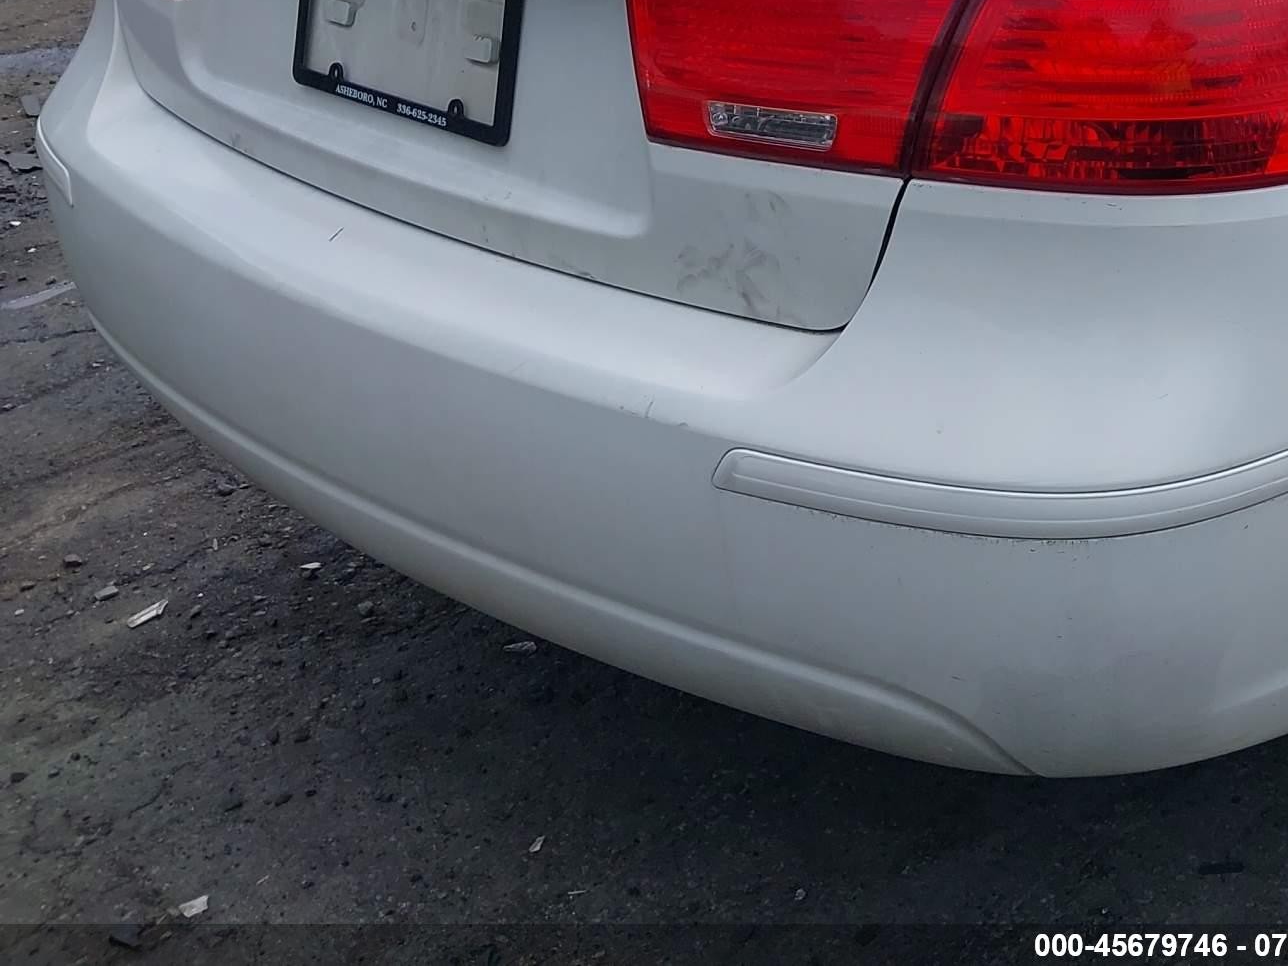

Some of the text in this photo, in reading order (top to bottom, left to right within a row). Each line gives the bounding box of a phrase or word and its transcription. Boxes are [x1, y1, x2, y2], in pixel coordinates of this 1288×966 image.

[335, 84, 447, 127] ASHEBORO, NC 336-625-2345
